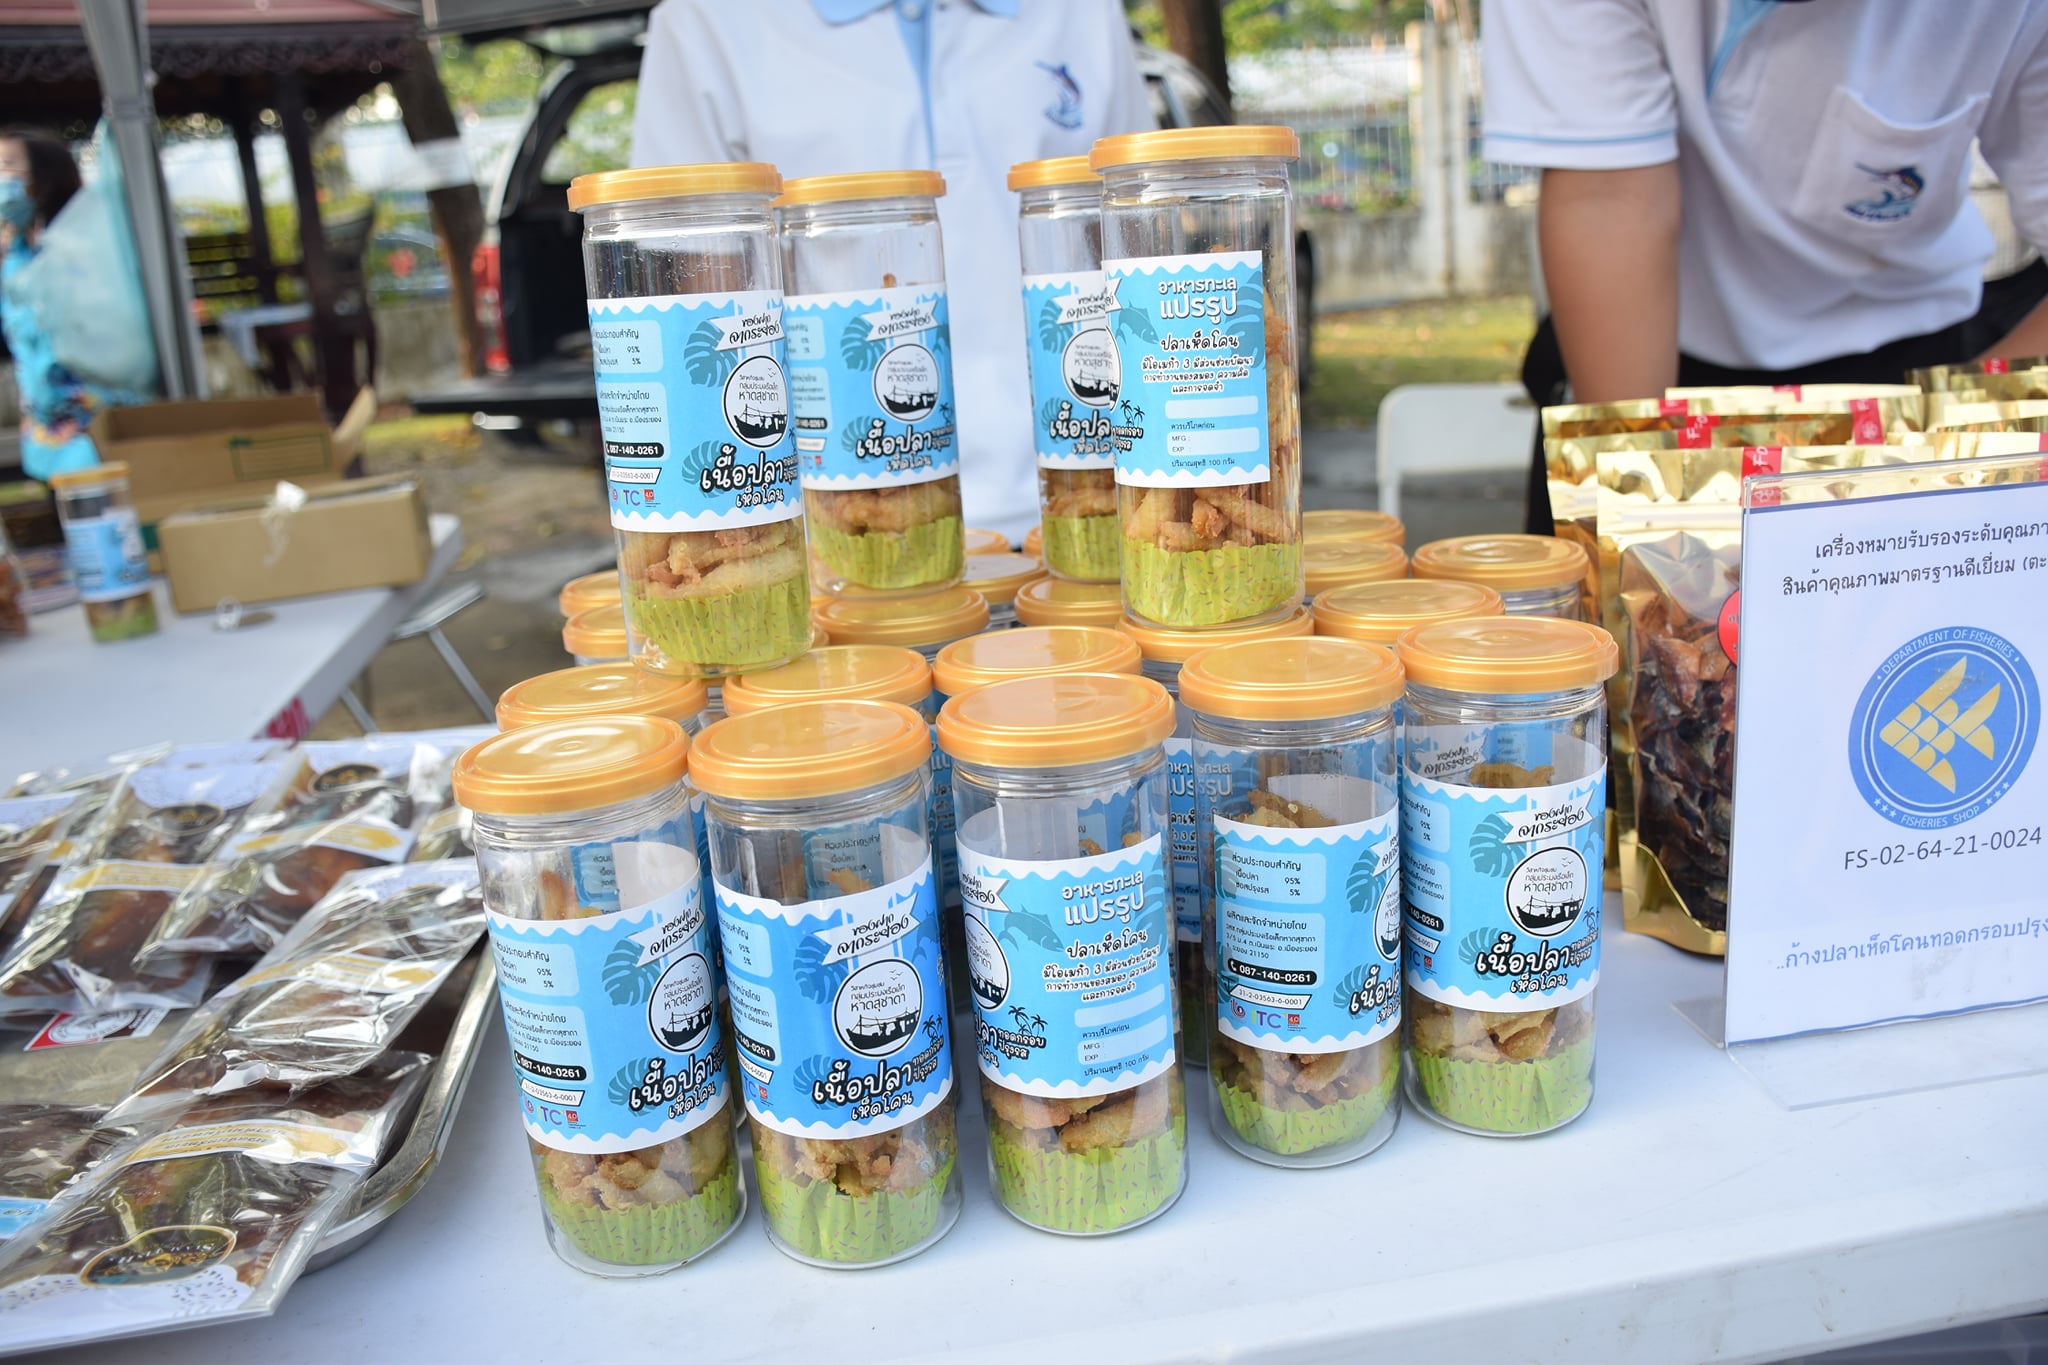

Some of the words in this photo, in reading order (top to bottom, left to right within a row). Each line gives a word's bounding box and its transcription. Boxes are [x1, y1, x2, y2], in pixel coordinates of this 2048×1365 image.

[1159, 277, 1237, 295] อาหารทะเล
[742, 312, 771, 327] ของฝาก
[1160, 291, 1237, 325] แปรรูป
[729, 320, 780, 344] จากระยอง
[1161, 327, 1238, 351] ปลาเห็ดโคน
[1183, 359, 1190, 369] 3
[739, 391, 778, 404] หาดสุชาดา
[1173, 381, 1224, 393] และการจดจำ
[1049, 400, 1111, 438] เนื้อปล
[856, 419, 932, 457] เนื้อปลา
[701, 444, 783, 491] เนื้อปลา
[736, 482, 784, 508] เห็ดโคน
[1783, 552, 2016, 595] สินค้าคุณภาพมาตรฐานดีเยี่ยม
[1882, 630, 1950, 675] DEPARTMENT
[1952, 629, 1968, 640] OF
[1969, 630, 2014, 659] FISHERIES
[1518, 807, 1584, 837] จากระยอง
[1535, 804, 1572, 821] ของฝาก
[1901, 813, 1948, 829] FISHERIES
[1952, 805, 1981, 824] SHOP
[1844, 827, 2043, 870] FS-02-64-21-0024
[1232, 852, 1301, 871] ส่วนประกอบสำคัญ
[1061, 871, 1144, 901] อาหารทะเล
[1284, 877, 1300, 885] 95%
[1289, 888, 1300, 896] 5%
[1524, 881, 1573, 895] หาดสุชาดา
[1064, 888, 1145, 926] แปรรูป
[649, 908, 700, 956] จากระยอง
[662, 908, 691, 934] ของฝาก
[852, 913, 894, 936] ของฝาก
[837, 914, 909, 956] จากระยอง
[1067, 928, 1147, 959] ปลาเห็ดโคน
[1249, 949, 1269, 959] 21150
[1476, 932, 1570, 976] เนื้อปลา
[537, 968, 552, 976] 95%
[1094, 964, 1102, 974] 3
[1239, 964, 1311, 982] 087-140-0261
[1083, 981, 1135, 1001] และการจดจำ
[1510, 971, 1568, 993] เห็ดโคน
[664, 986, 704, 1011] หาดสุชาดา
[851, 994, 906, 1012] หาดสุชาดา
[1239, 989, 1302, 1005] 31-2-03563-6-0001
[1251, 1009, 1281, 1028] ITC
[999, 1027, 1047, 1048] ทอดกรอบ
[1084, 1042, 1100, 1050] MFG
[520, 1058, 580, 1078] 087-140-0261
[913, 1057, 937, 1082] ปรุงรส
[1085, 1054, 1098, 1062] EXP
[1125, 1060, 1136, 1068] 100
[629, 1053, 714, 1111] เนื้อปลา
[812, 1059, 912, 1105] เนื้อปลา
[668, 1081, 716, 1119] เห็ดโคน
[851, 1089, 914, 1121] เห็ดโคน
